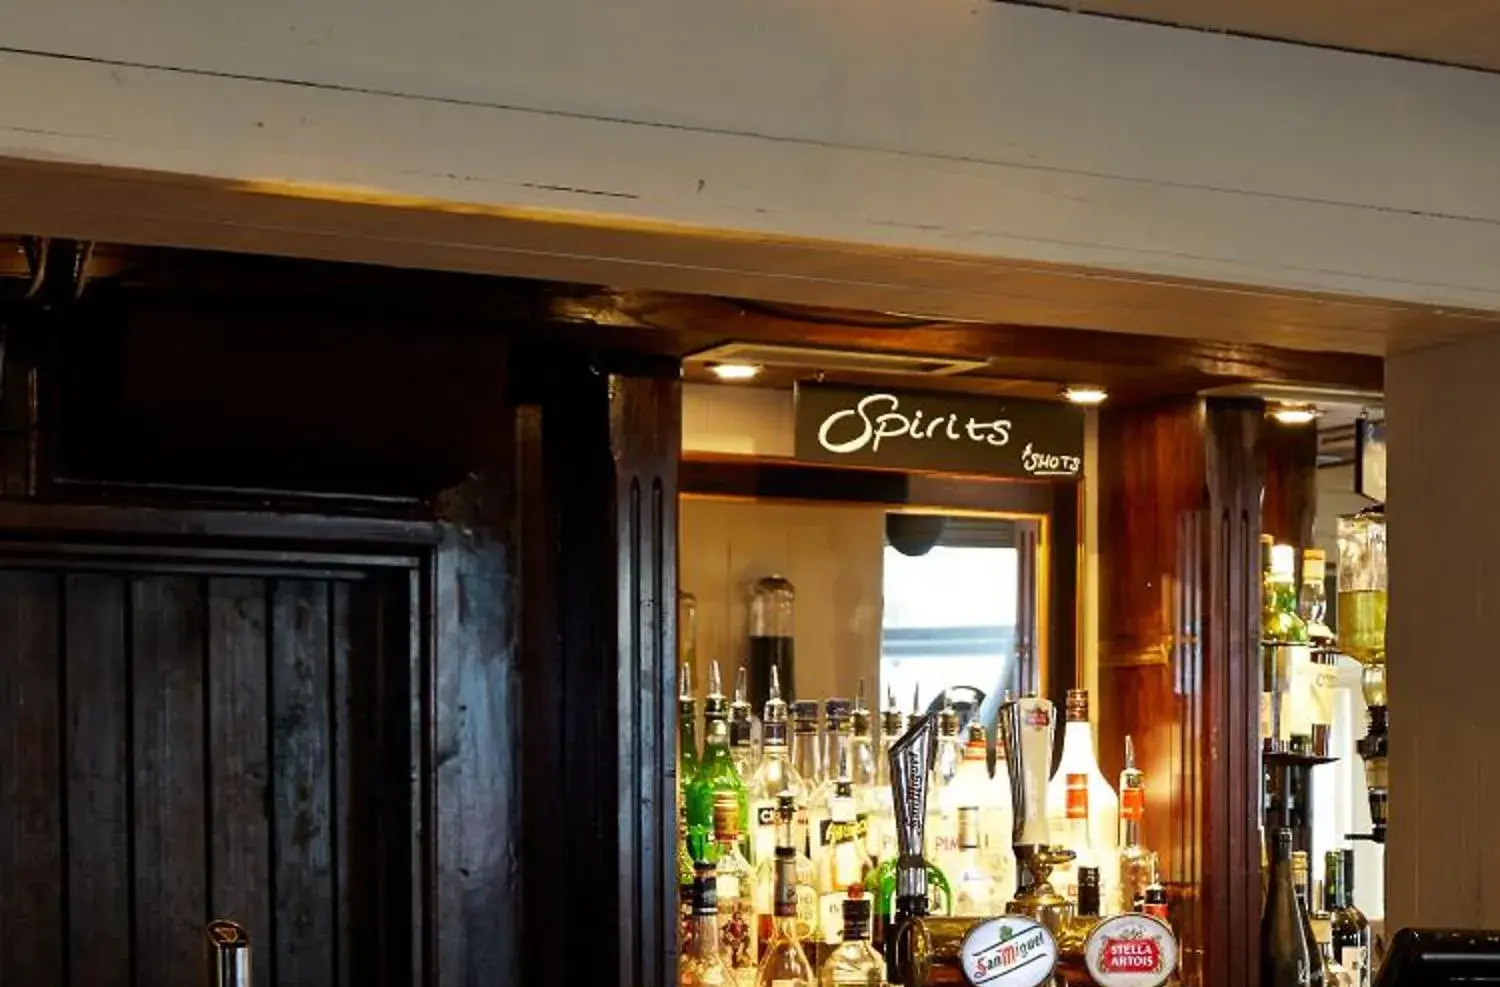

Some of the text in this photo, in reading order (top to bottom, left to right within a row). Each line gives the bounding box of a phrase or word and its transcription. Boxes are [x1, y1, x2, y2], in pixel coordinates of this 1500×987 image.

[818, 393, 1012, 452] Spirits
[1111, 944, 1153, 956] STELLA
[1111, 956, 1154, 968] ARTOIS
